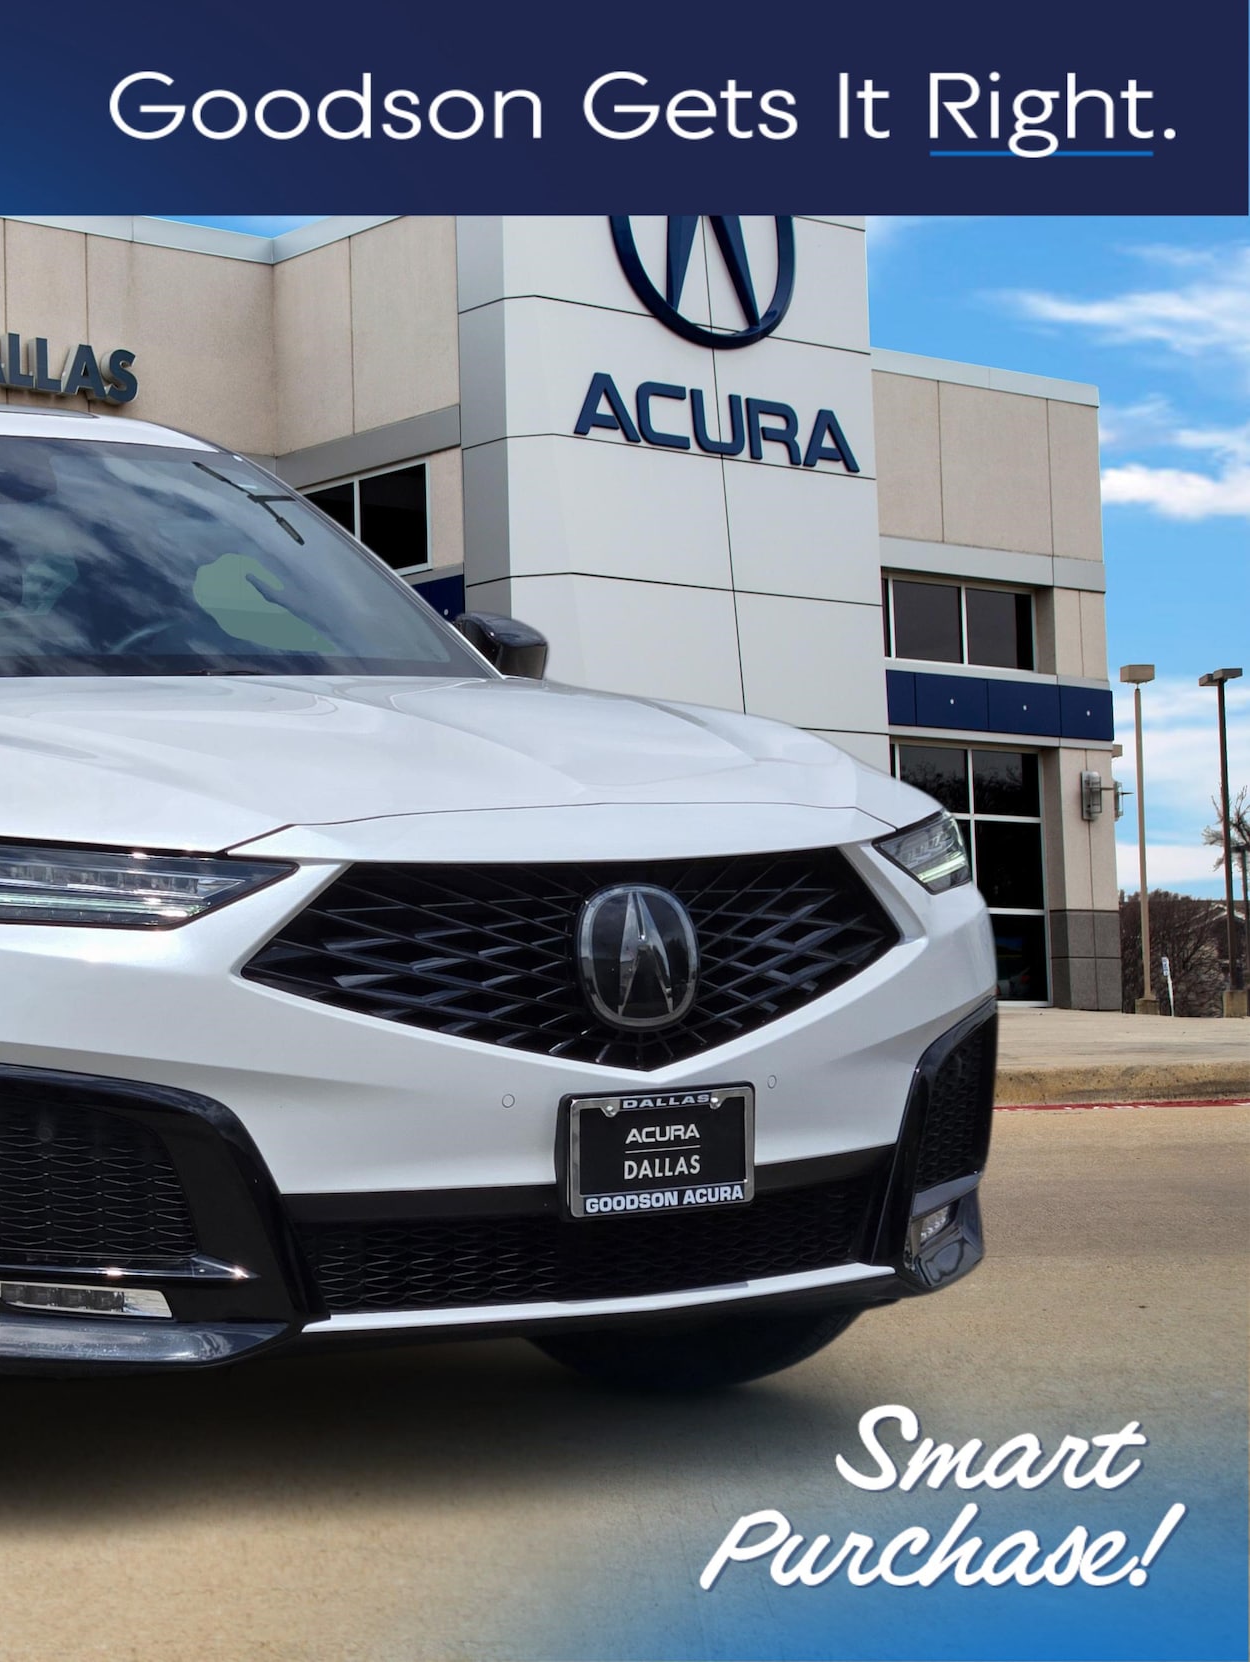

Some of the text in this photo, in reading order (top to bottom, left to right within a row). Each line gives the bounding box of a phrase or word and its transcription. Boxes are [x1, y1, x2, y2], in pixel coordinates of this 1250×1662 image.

[573, 372, 860, 474] ACURA
[622, 1093, 710, 1109] DALLAS
[625, 1123, 700, 1145] ACURA
[624, 1154, 701, 1180] DALLAS
[585, 1183, 745, 1214] GOODSON ACURA
